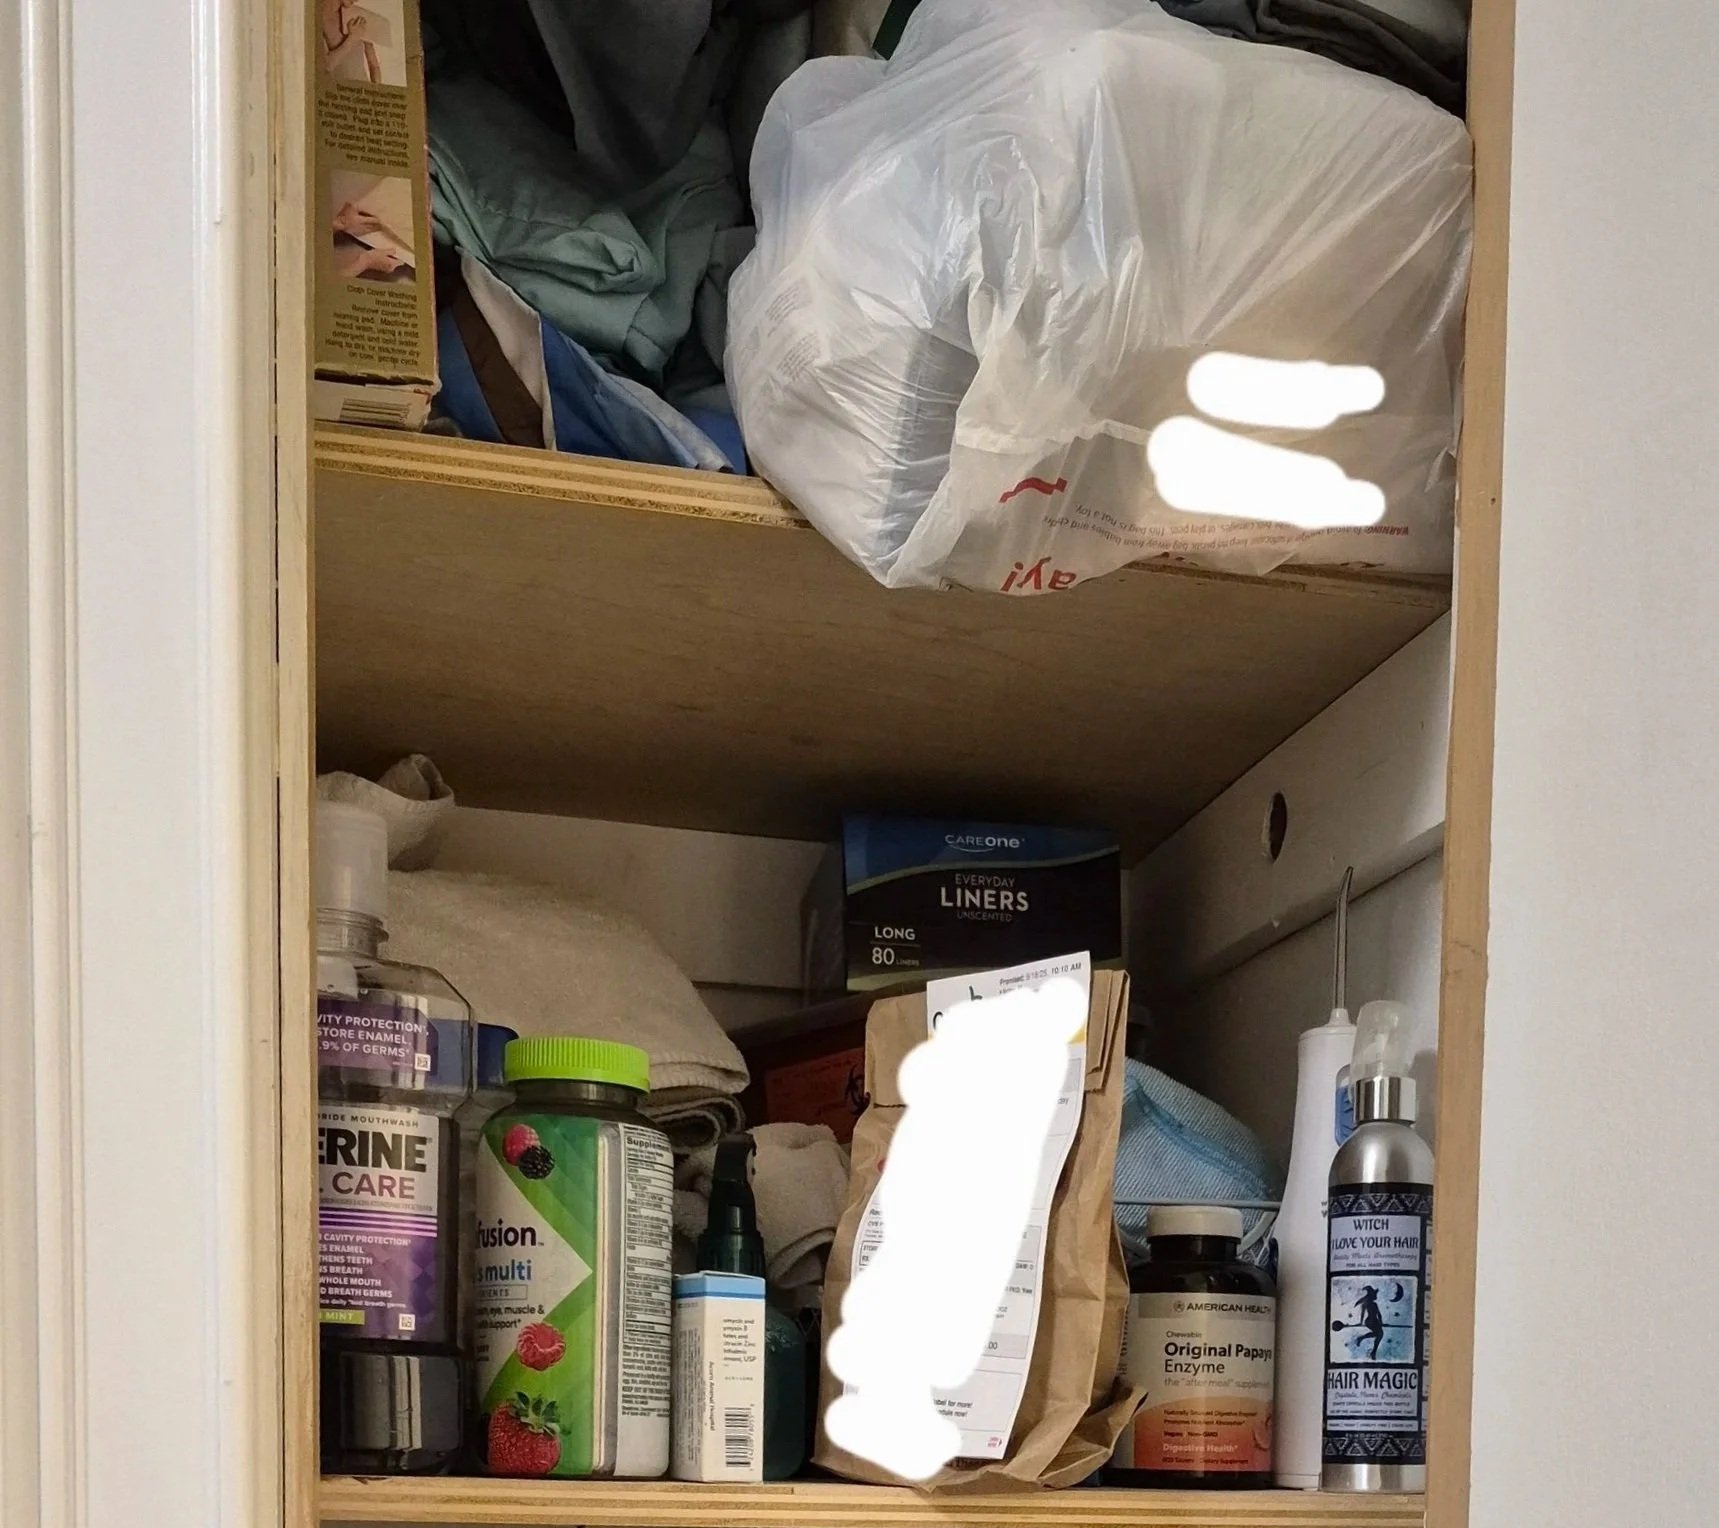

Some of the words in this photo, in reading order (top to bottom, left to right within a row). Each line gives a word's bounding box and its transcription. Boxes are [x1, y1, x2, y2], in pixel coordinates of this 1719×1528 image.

[944, 834, 1021, 849] CAREone
[955, 873, 1015, 888] EVERYDAY
[940, 886, 1029, 912] LINERS
[957, 911, 1013, 922] UNSCENTED
[874, 926, 916, 941] LONG
[872, 946, 895, 965] 80
[343, 1042, 360, 1053] OF
[350, 1114, 419, 1128] MOUTHWASH
[332, 1171, 415, 1200] CARE
[1352, 1218, 1390, 1232] WITCH
[324, 1233, 355, 1242] CAVITY
[1335, 1236, 1358, 1250] LOVE
[1358, 1236, 1392, 1249] YOUR
[1393, 1236, 1419, 1250] HAIR
[329, 1245, 364, 1254] ENAMEL
[347, 1255, 373, 1265] TEETH
[330, 1266, 364, 1275] BREATH
[485, 1258, 532, 1281] multi
[350, 1278, 382, 1287] MOUTH
[328, 1288, 362, 1296] BREATH
[363, 1289, 393, 1299] GERMS
[504, 1305, 535, 1315] muscle
[537, 1304, 545, 1314] &
[1186, 1302, 1243, 1313] AMERICAN
[325, 1312, 354, 1321] MINT
[1164, 1341, 1232, 1360] Original
[1164, 1358, 1226, 1377] Enzyme
[1164, 1378, 1180, 1387] the
[1327, 1371, 1359, 1390] HAIR
[1362, 1371, 1417, 1390] MAGIC
[1163, 1443, 1205, 1454] Digestive
